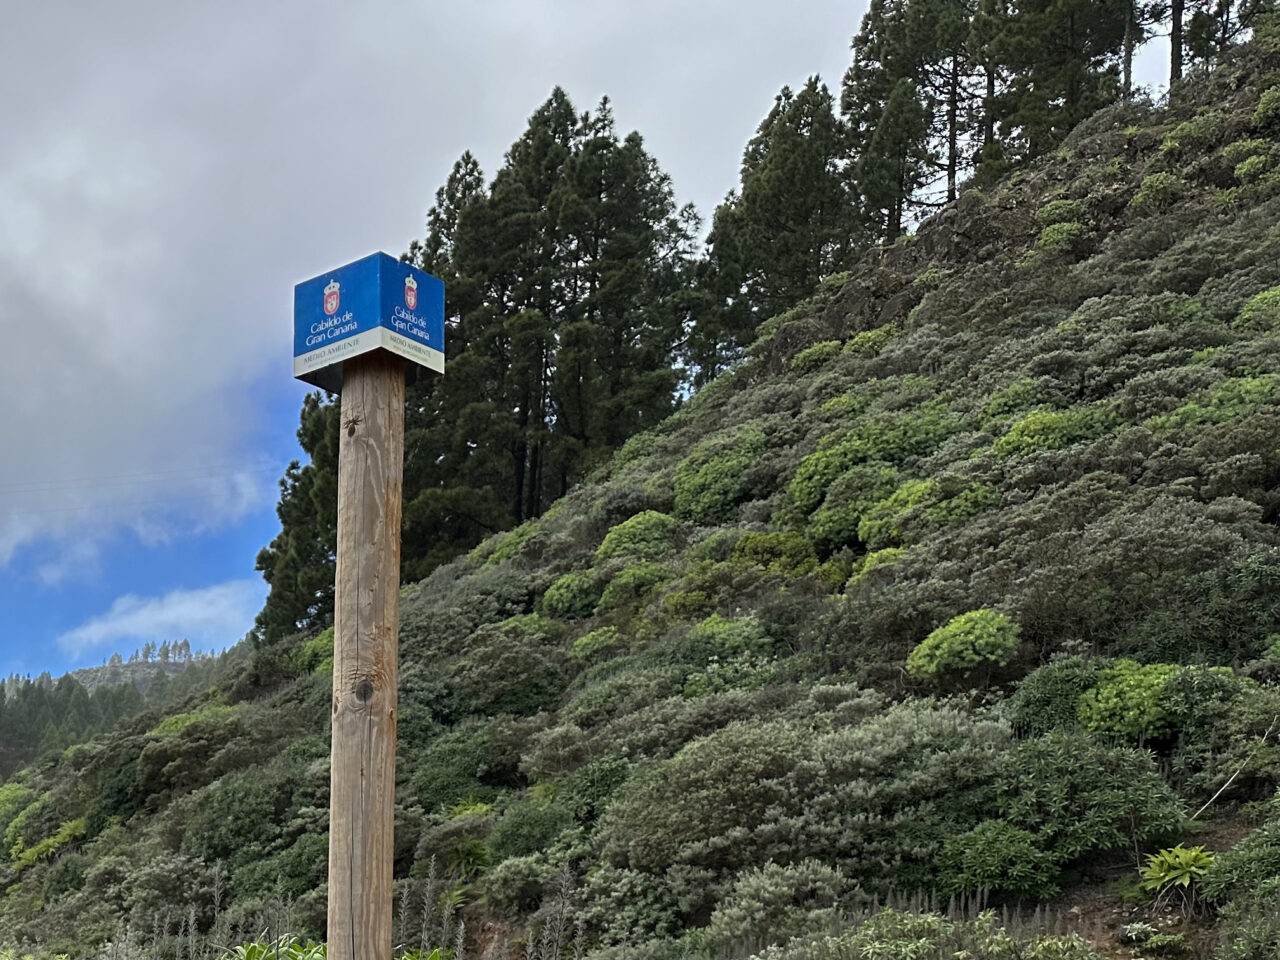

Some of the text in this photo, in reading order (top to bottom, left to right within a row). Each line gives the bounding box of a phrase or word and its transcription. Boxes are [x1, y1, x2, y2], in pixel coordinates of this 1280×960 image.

[310, 310, 353, 334] Cabildo de
[391, 315, 430, 341] Gran Canaria
[395, 306, 427, 328] Cabildo de
[305, 321, 358, 346] Gran Canaria
[304, 350, 326, 364] MEDIO
[327, 339, 360, 355] AMBIENTE
